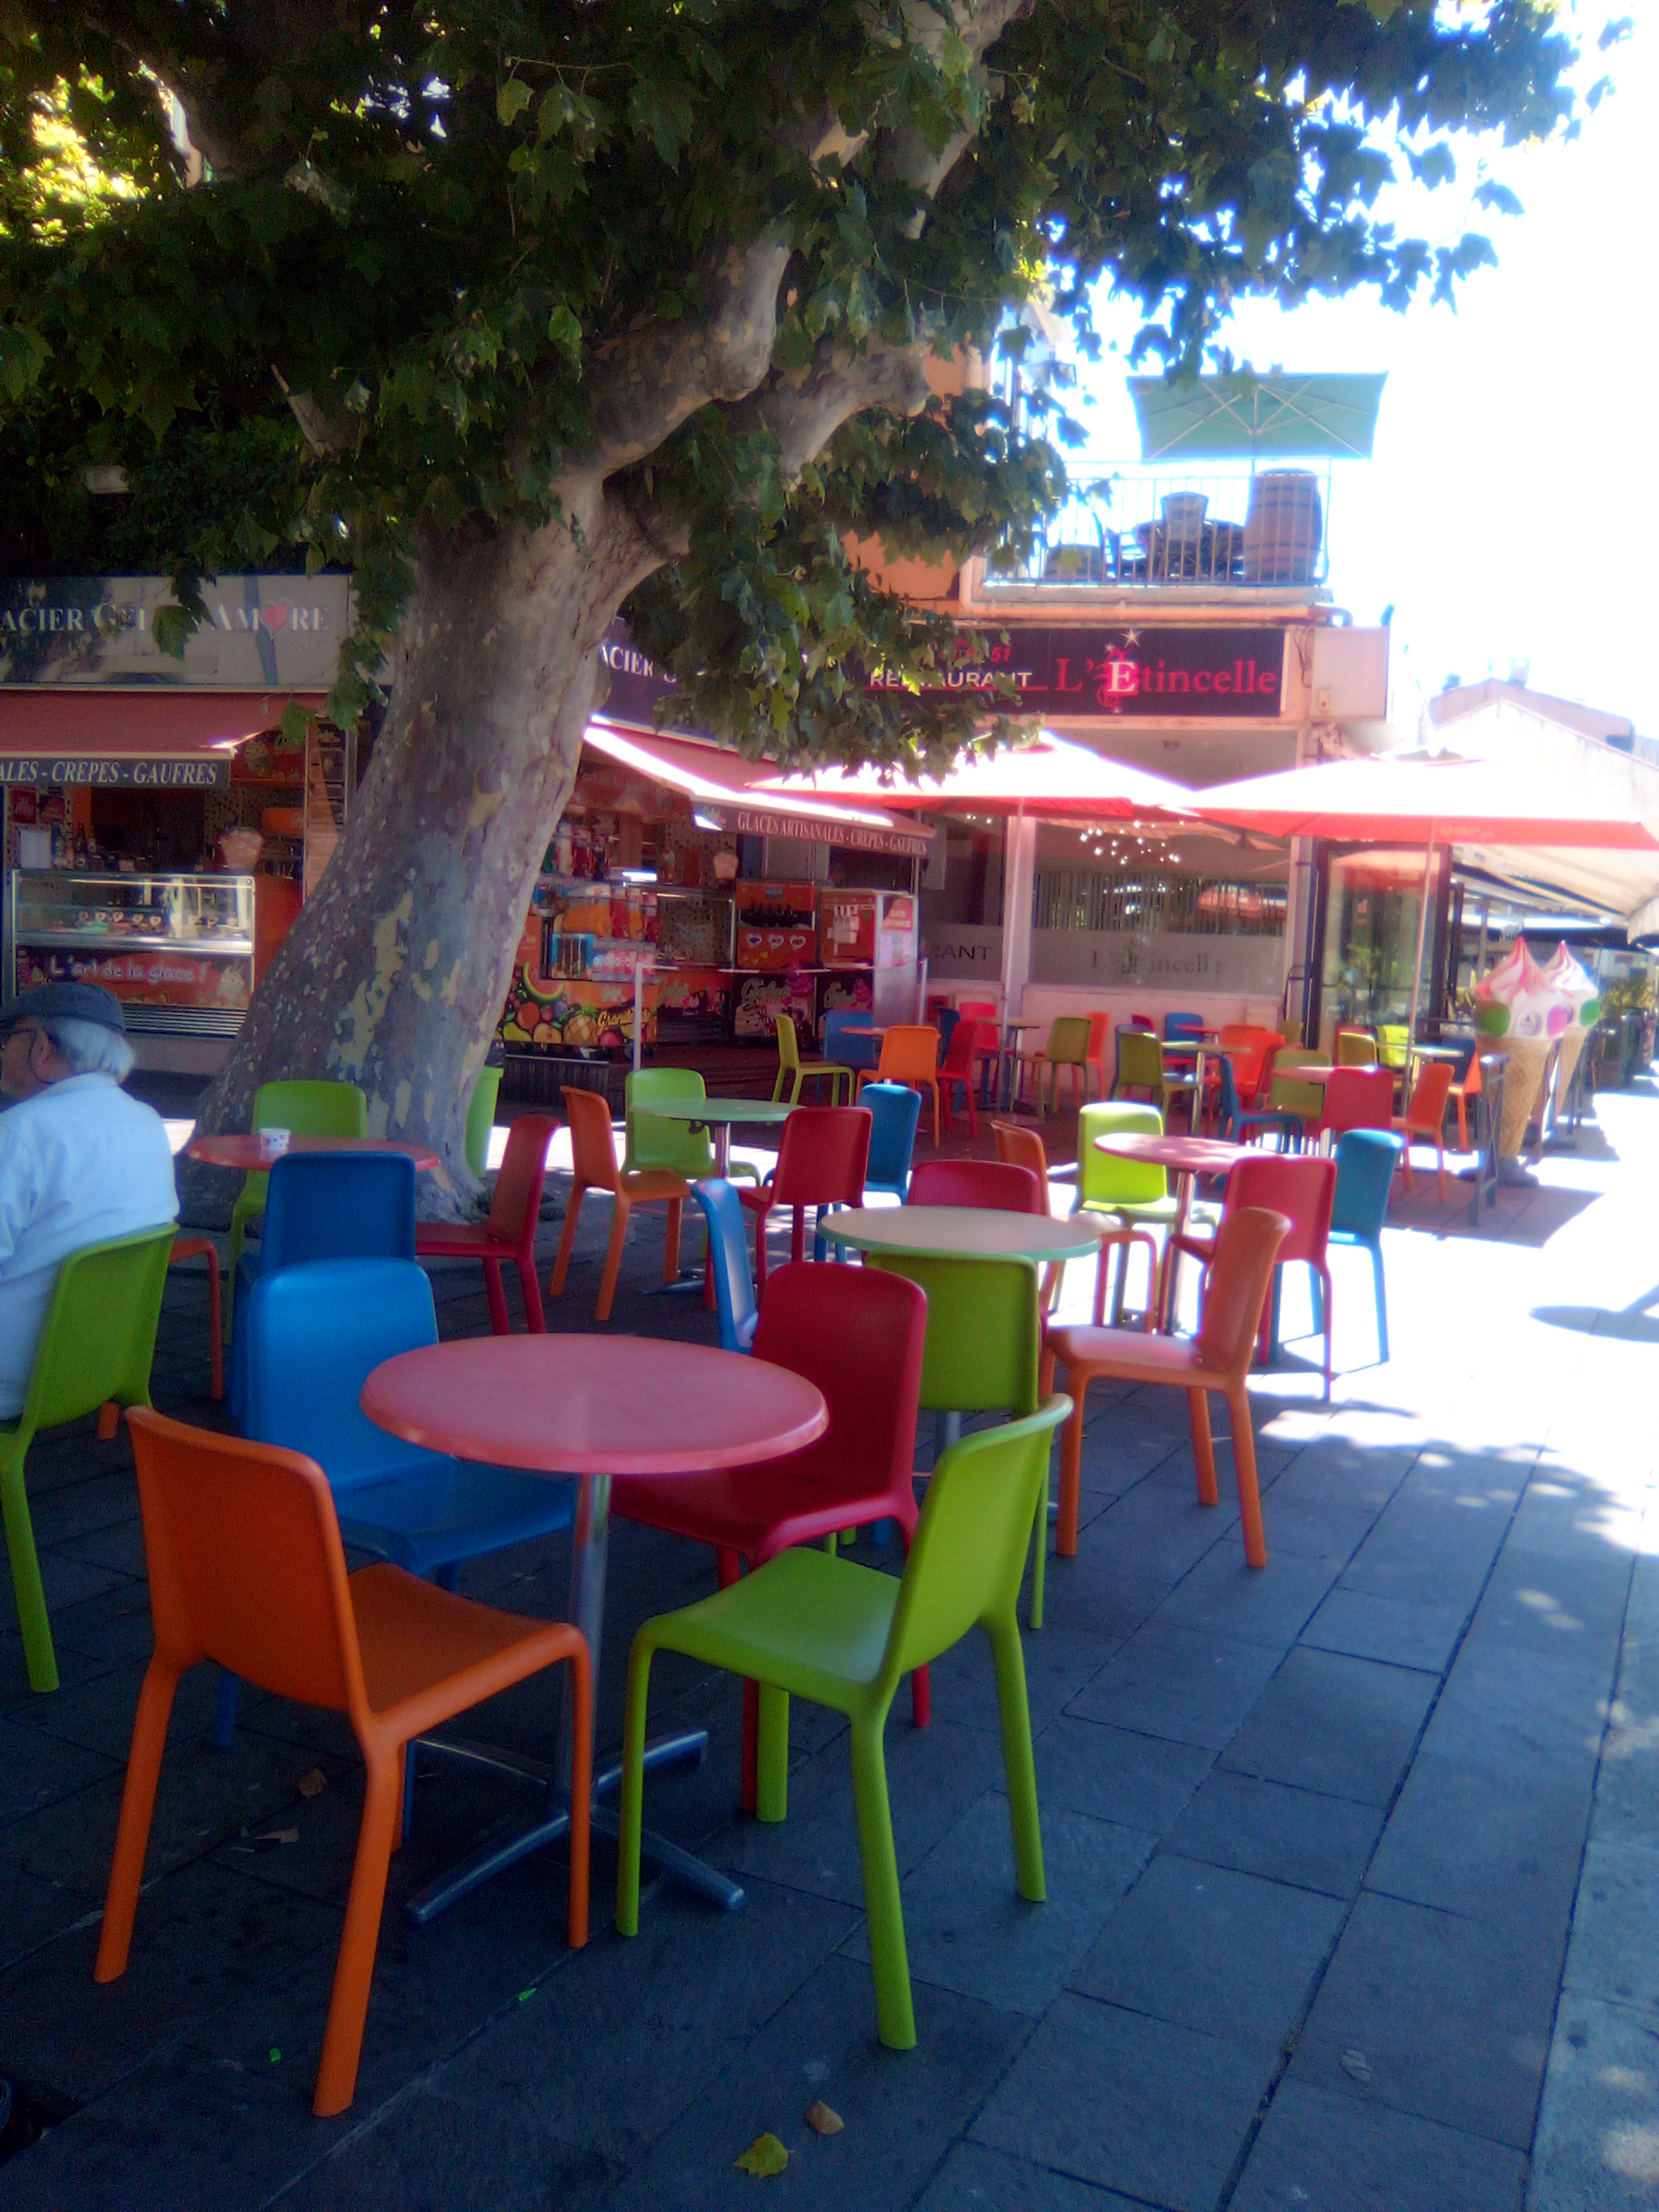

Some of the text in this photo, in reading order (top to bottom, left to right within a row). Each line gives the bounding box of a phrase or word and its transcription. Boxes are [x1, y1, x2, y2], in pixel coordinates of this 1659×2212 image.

[989, 646, 1012, 663] 51
[869, 672, 1033, 688] REURAT
[52, 761, 119, 783] CREPES
[134, 762, 218, 785] GAUFRES
[737, 813, 779, 835] GLACES
[781, 819, 844, 844] ARTISANALES
[851, 828, 884, 849] CREPES
[889, 835, 927, 855] GAUFRES
[102, 959, 123, 977] de
[127, 959, 144, 979] la
[147, 959, 196, 985] glace
